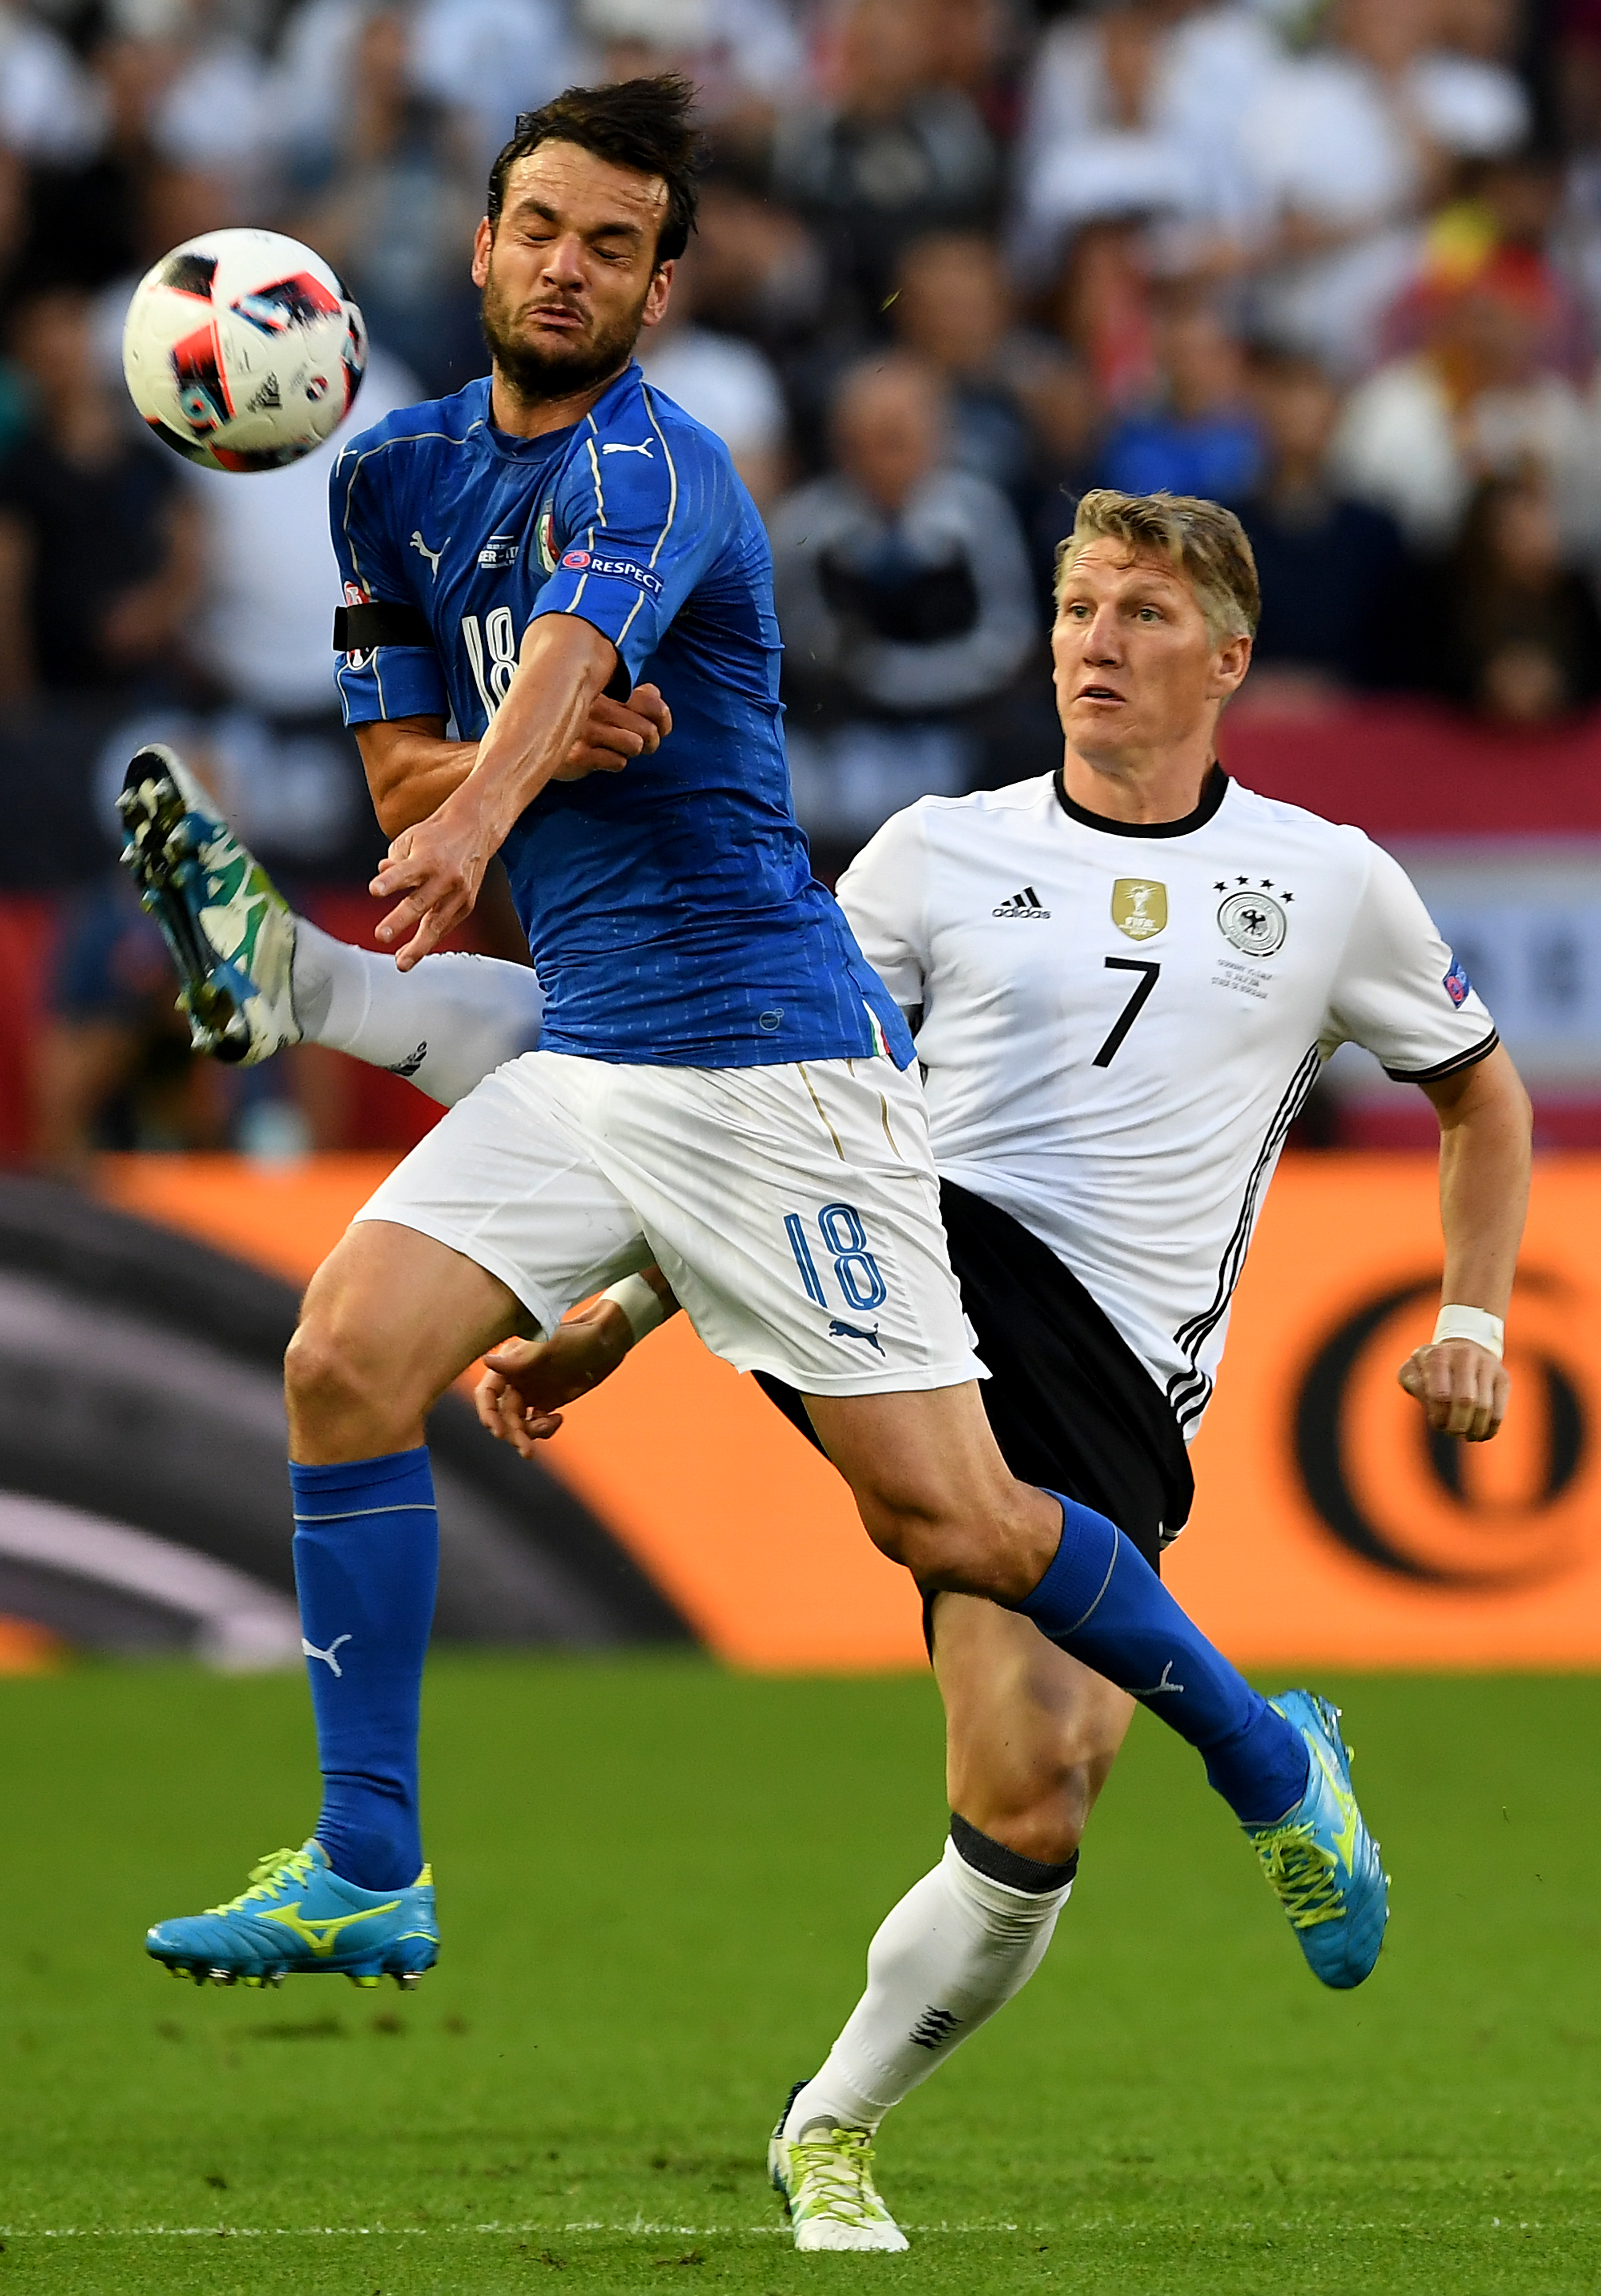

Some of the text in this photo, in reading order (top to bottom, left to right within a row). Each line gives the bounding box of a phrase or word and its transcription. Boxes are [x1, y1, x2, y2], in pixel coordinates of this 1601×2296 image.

[591, 559, 663, 593] RESPECT
[461, 606, 519, 725] 18
[991, 906, 1051, 919] adidas
[1091, 956, 1161, 1068] 7
[783, 1202, 888, 1311] 18
